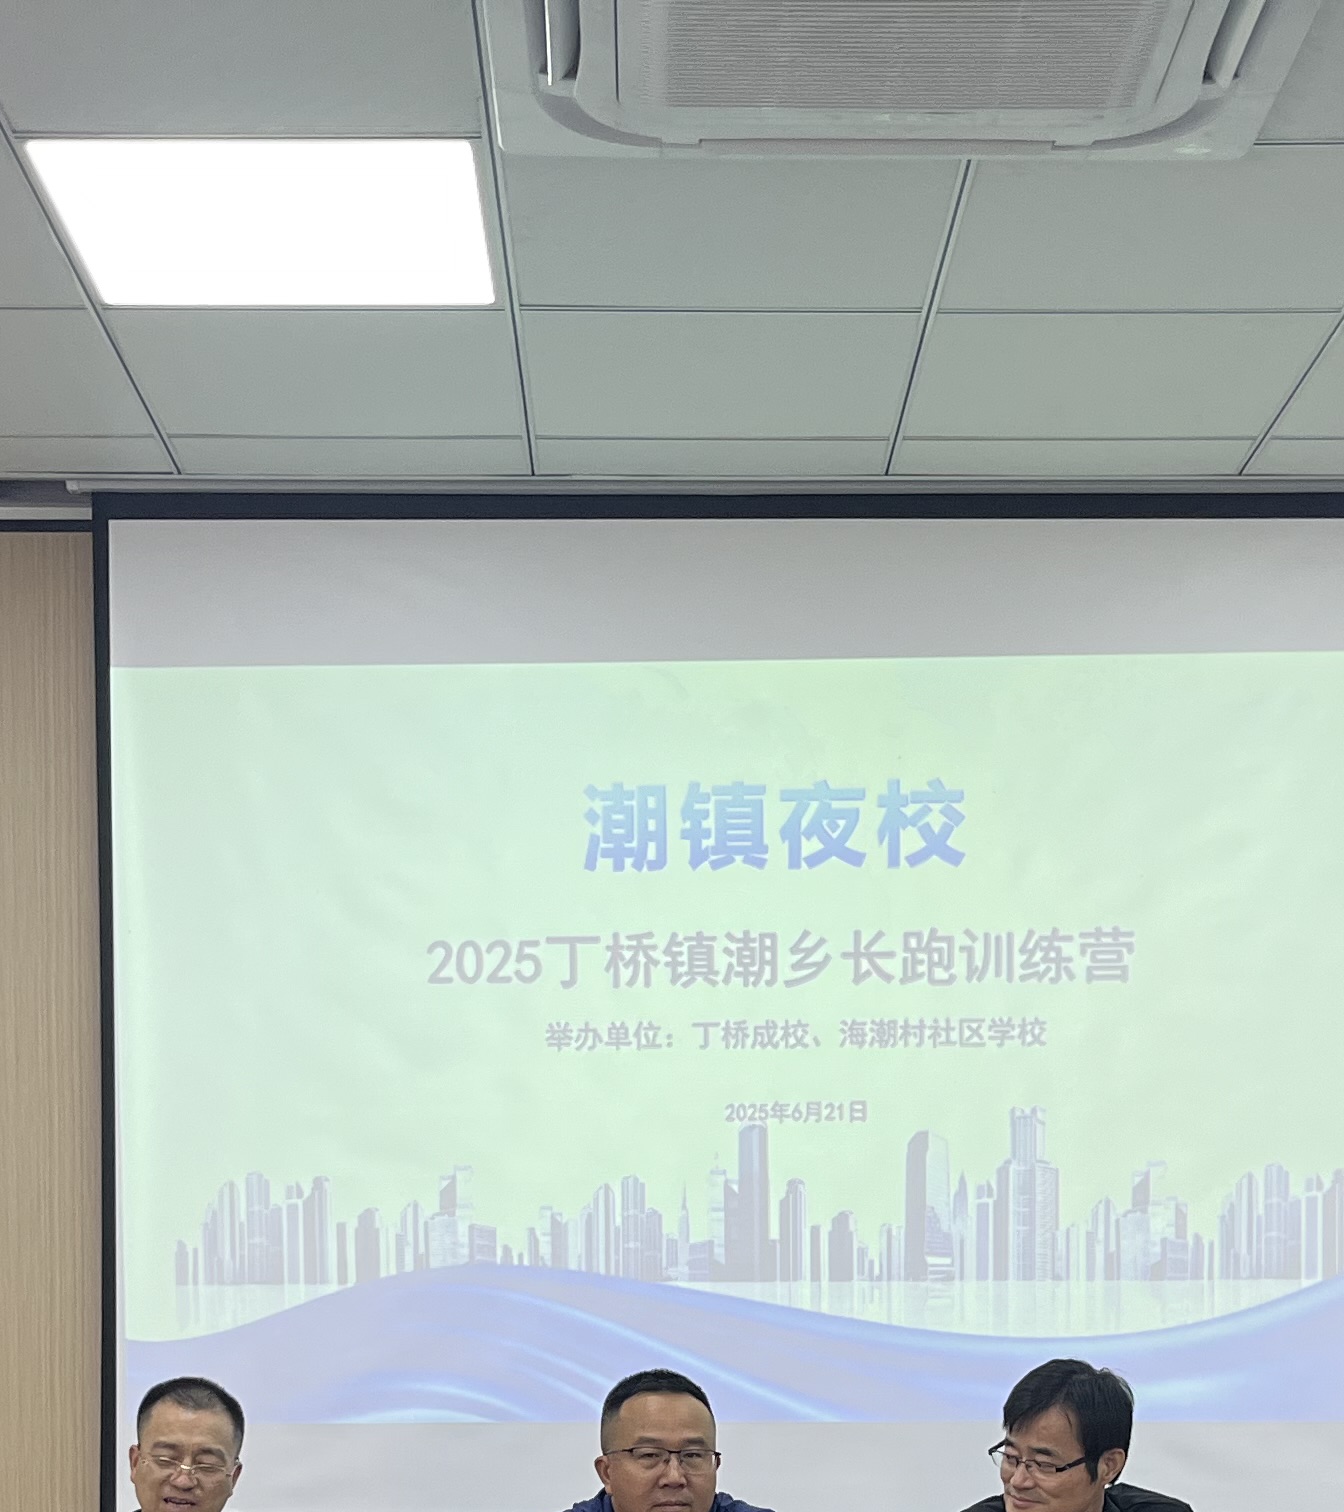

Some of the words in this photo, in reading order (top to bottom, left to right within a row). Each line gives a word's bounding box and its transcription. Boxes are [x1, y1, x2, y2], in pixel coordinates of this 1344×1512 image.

[583, 778, 966, 871] 潮镇夜校
[426, 926, 1135, 989] 2025丁桥镇潮乡长跑训练营
[724, 1100, 868, 1124] 2025年6月21日
